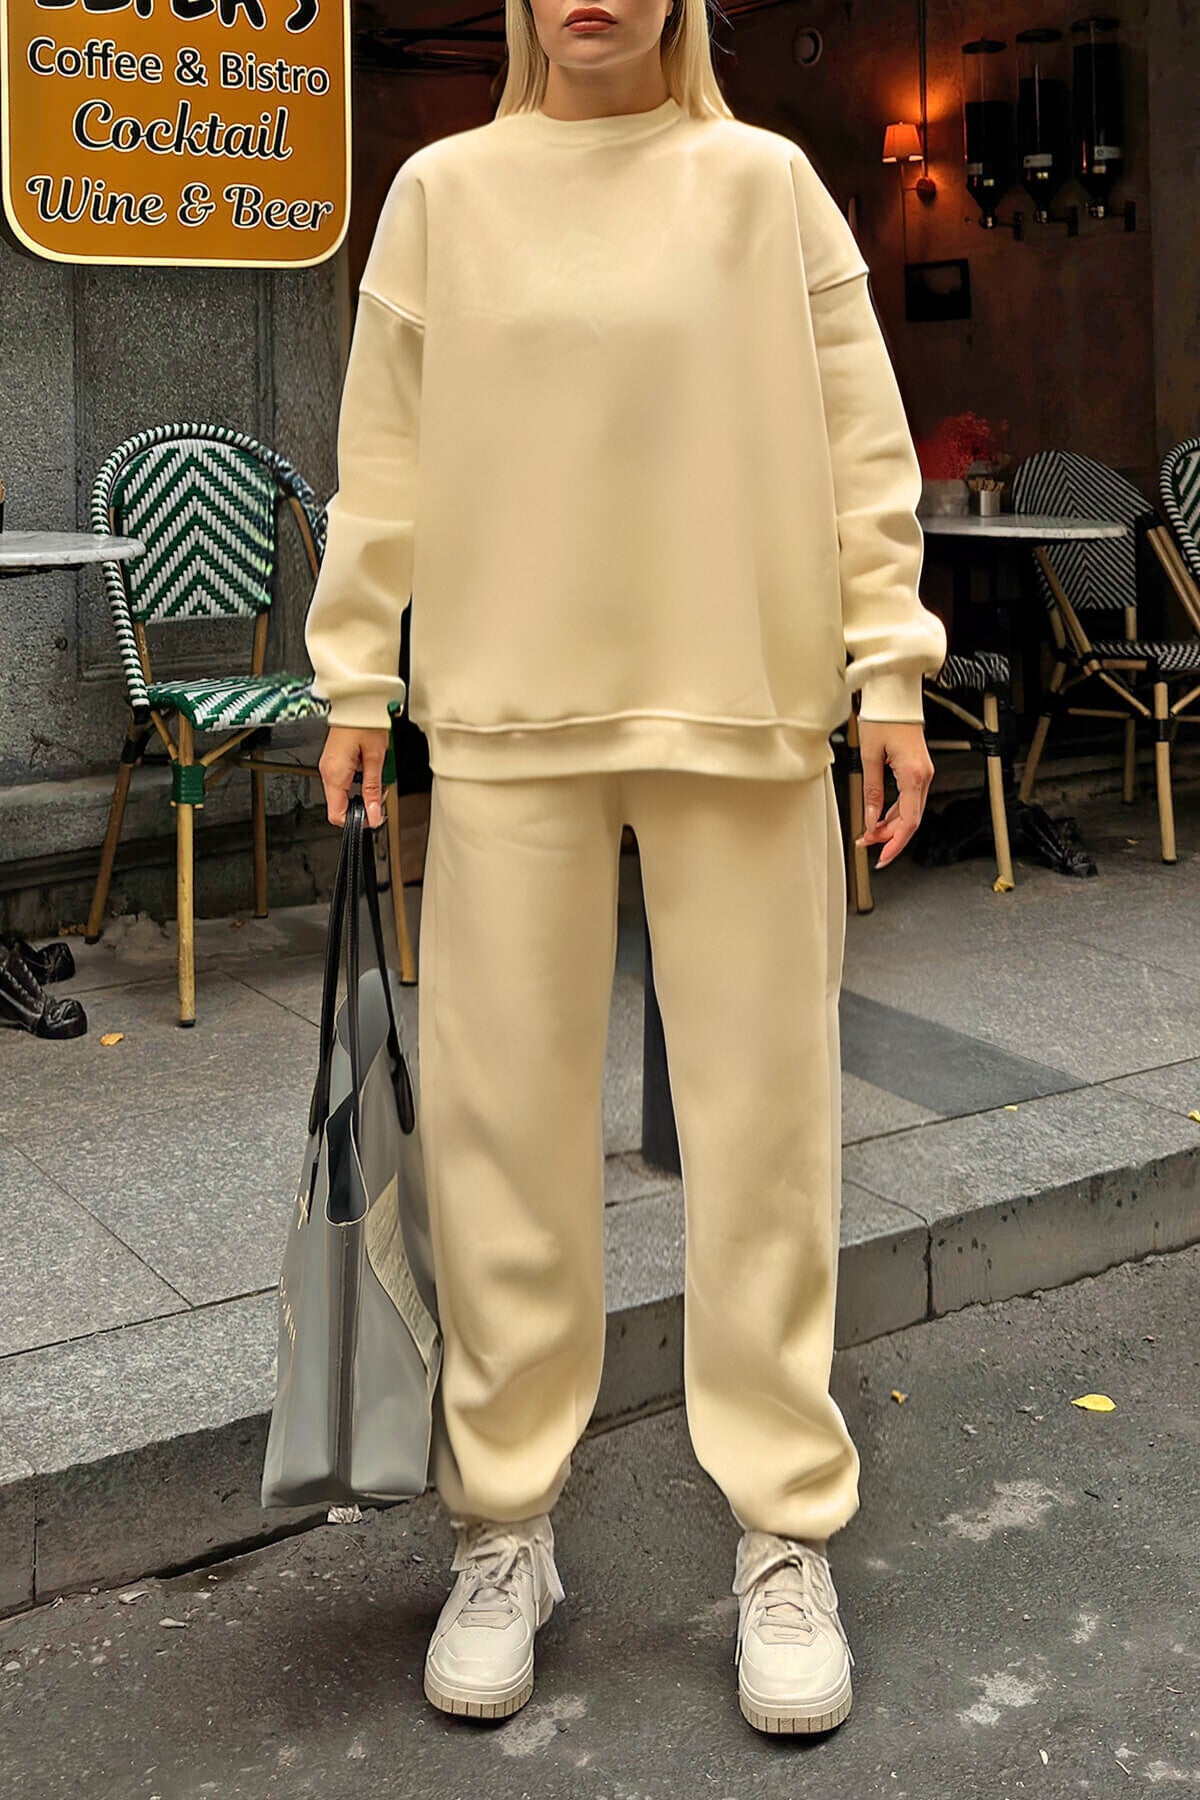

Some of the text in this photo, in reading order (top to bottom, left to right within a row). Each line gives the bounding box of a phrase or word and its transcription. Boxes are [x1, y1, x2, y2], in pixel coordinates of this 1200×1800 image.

[28, 37, 330, 96] Coffee & Bistro
[73, 99, 293, 161] Cocktail
[26, 175, 334, 231] Wine & Beer
